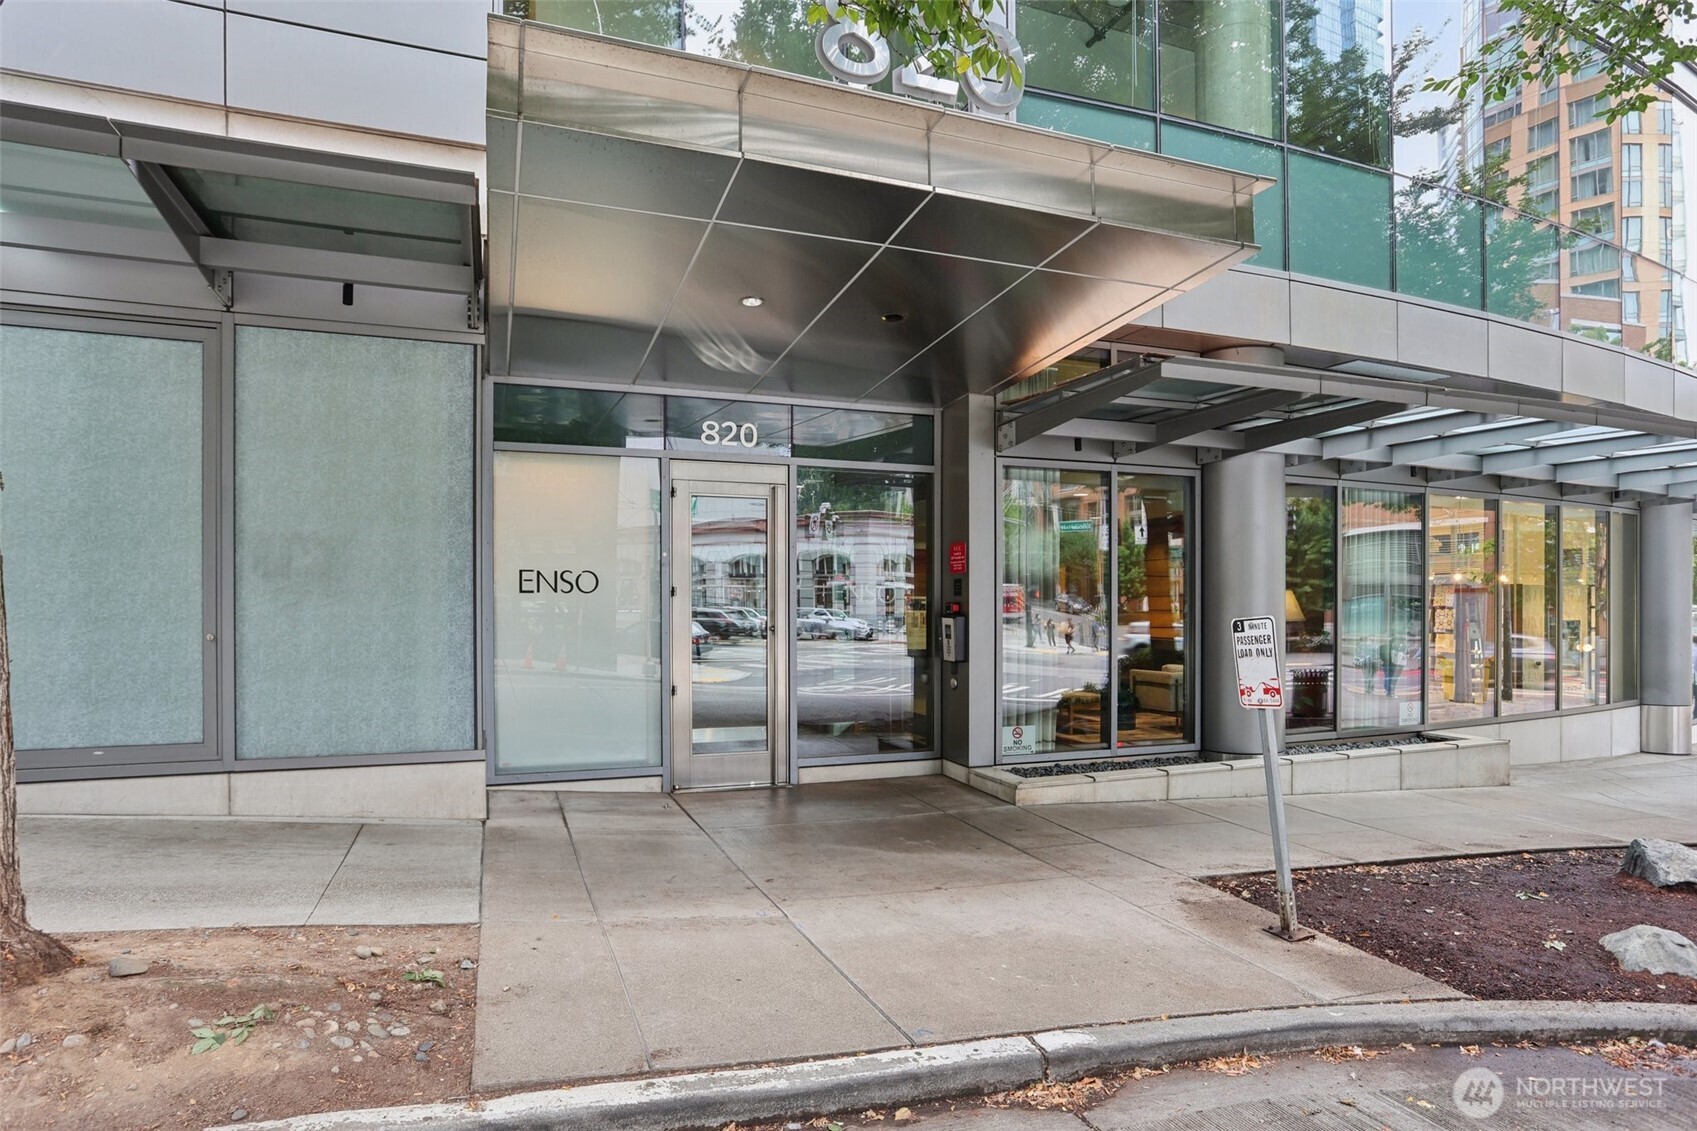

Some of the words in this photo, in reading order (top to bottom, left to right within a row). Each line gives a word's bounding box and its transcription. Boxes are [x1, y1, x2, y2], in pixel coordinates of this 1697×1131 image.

[700, 421, 758, 448] 820
[518, 569, 599, 594] ENSO
[1237, 622, 1242, 632] 3
[1237, 634, 1272, 645] PASSENGER
[1238, 648, 1253, 658] LOAD
[1255, 647, 1273, 658] ONLY
